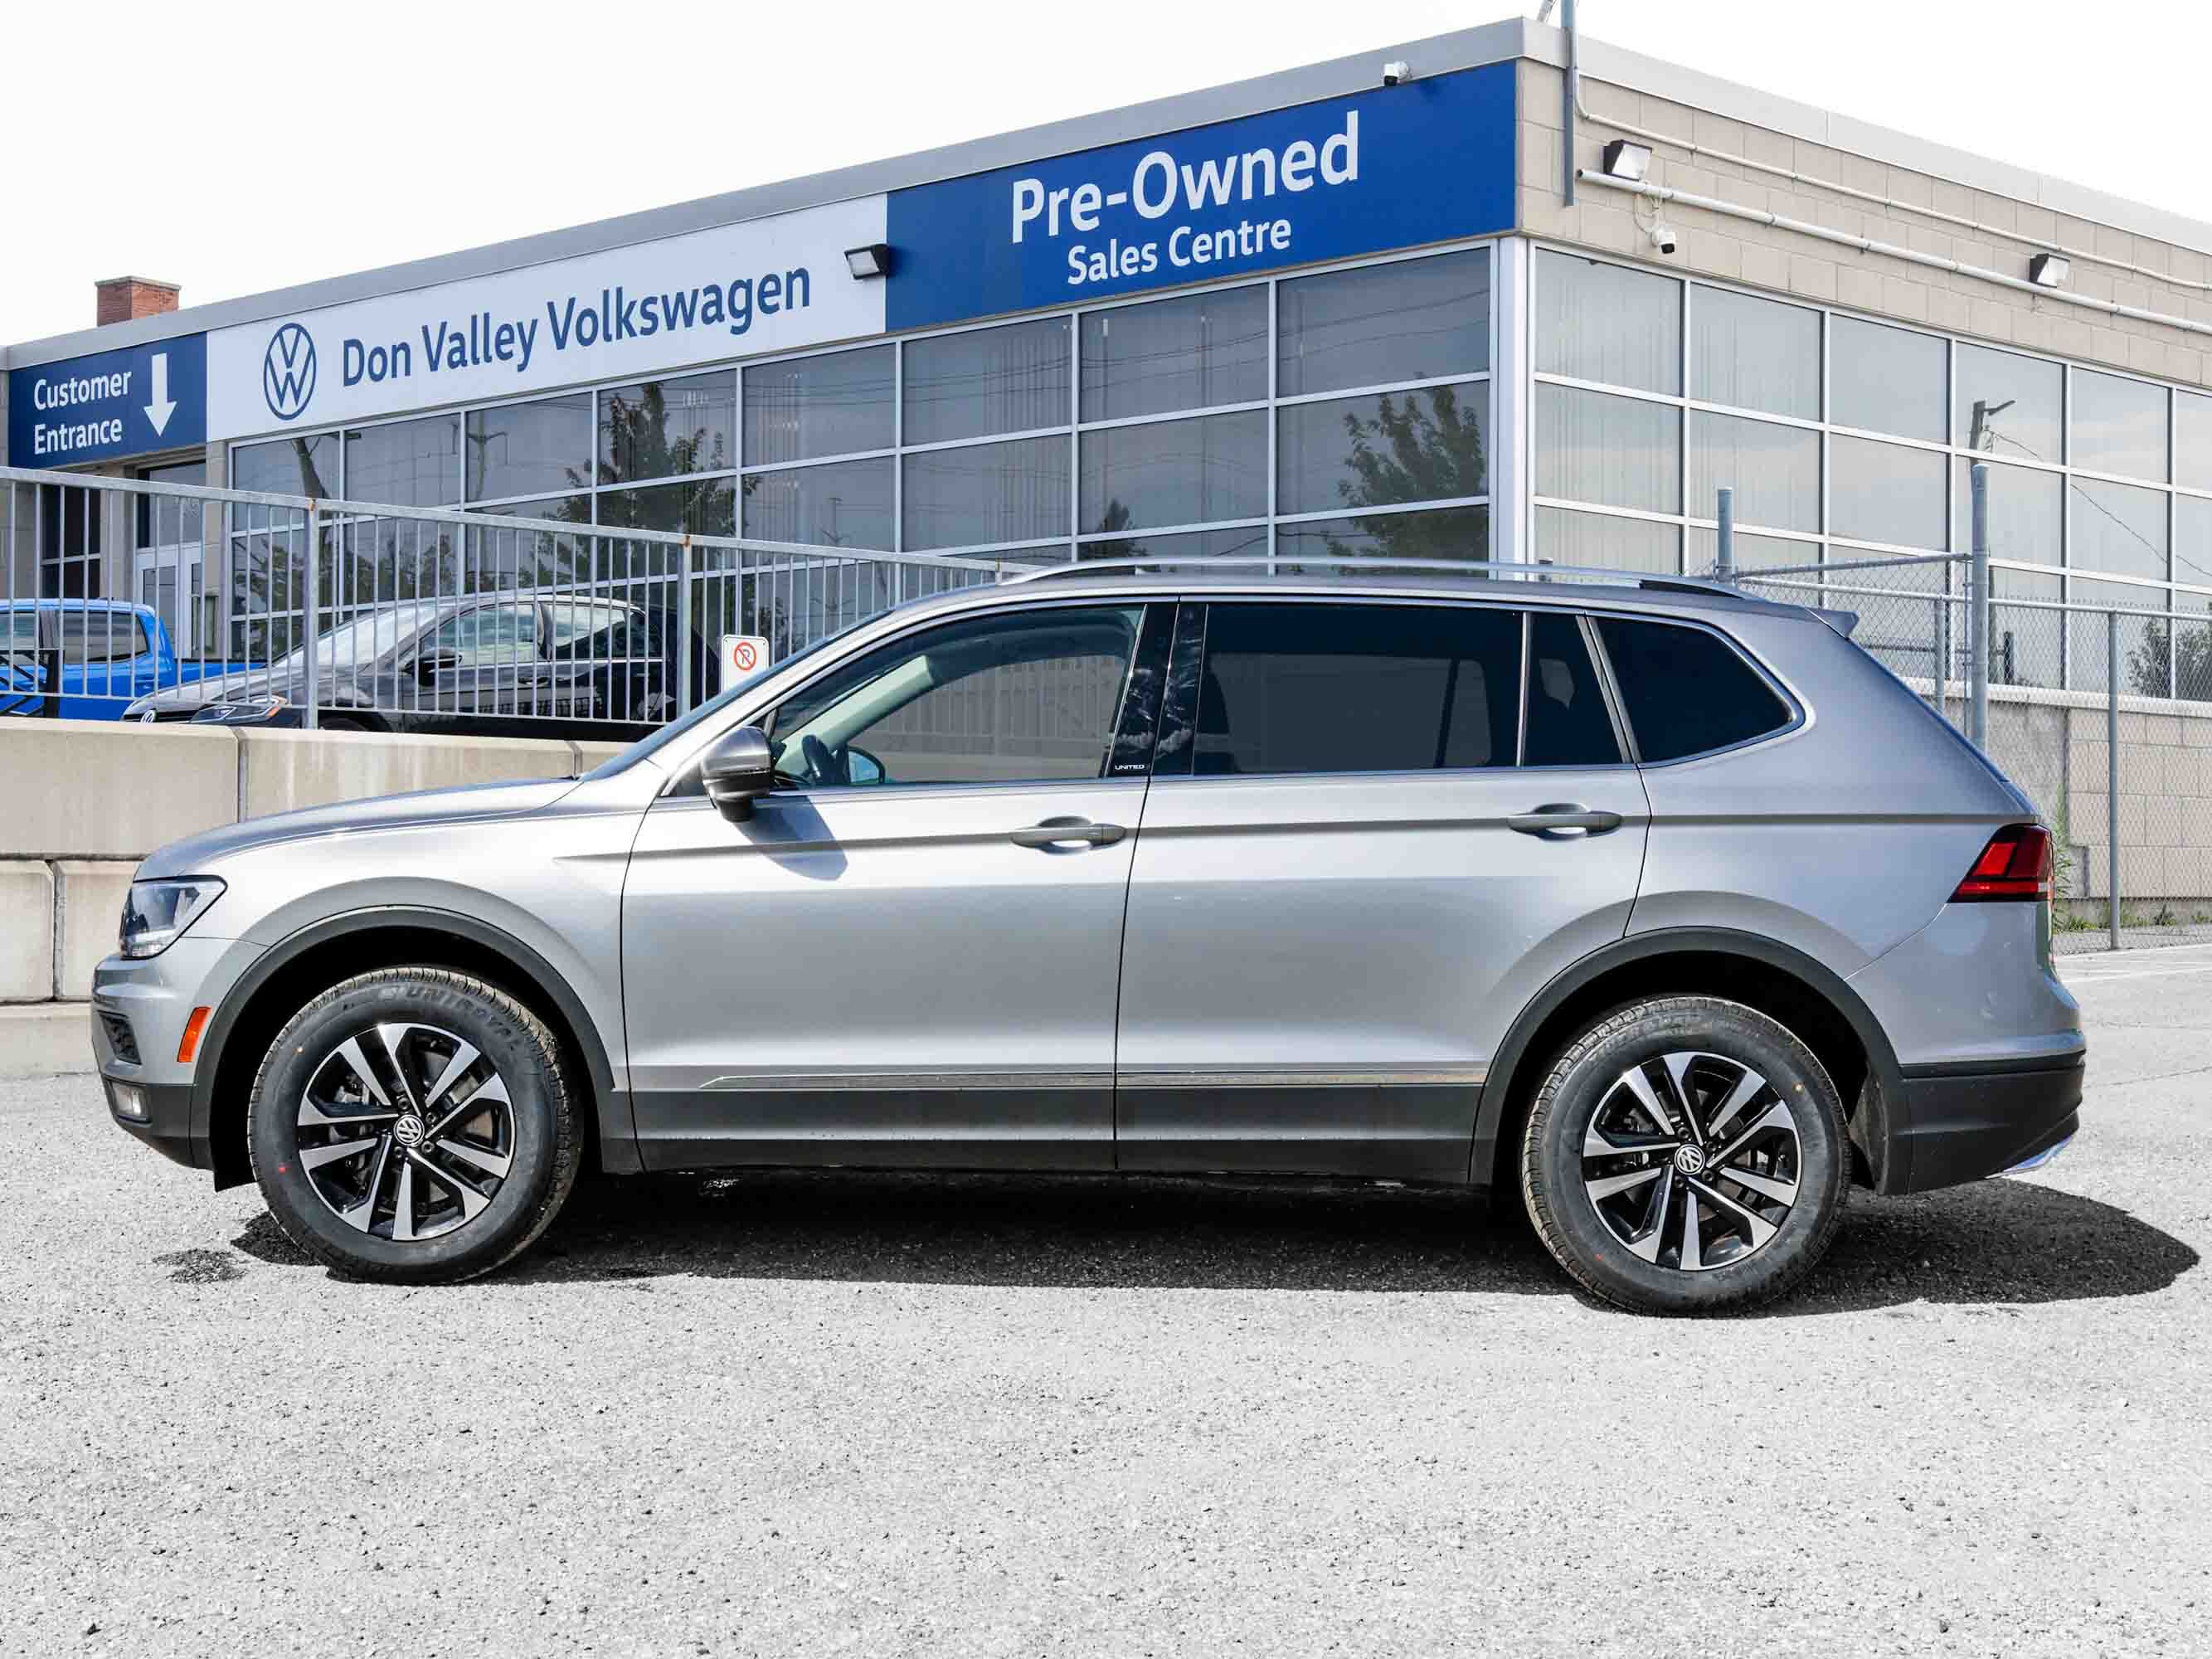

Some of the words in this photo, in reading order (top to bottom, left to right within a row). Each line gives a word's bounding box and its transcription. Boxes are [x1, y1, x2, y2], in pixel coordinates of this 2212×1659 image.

[1012, 110, 1359, 244] Pre-Owned
[1067, 238, 1158, 285] Sales
[1169, 218, 1291, 266] Centre
[343, 338, 411, 387] Don
[422, 312, 537, 372] Valley
[547, 266, 810, 351] Volkswagen
[34, 371, 132, 411] Customer
[34, 418, 122, 455] Entrance
